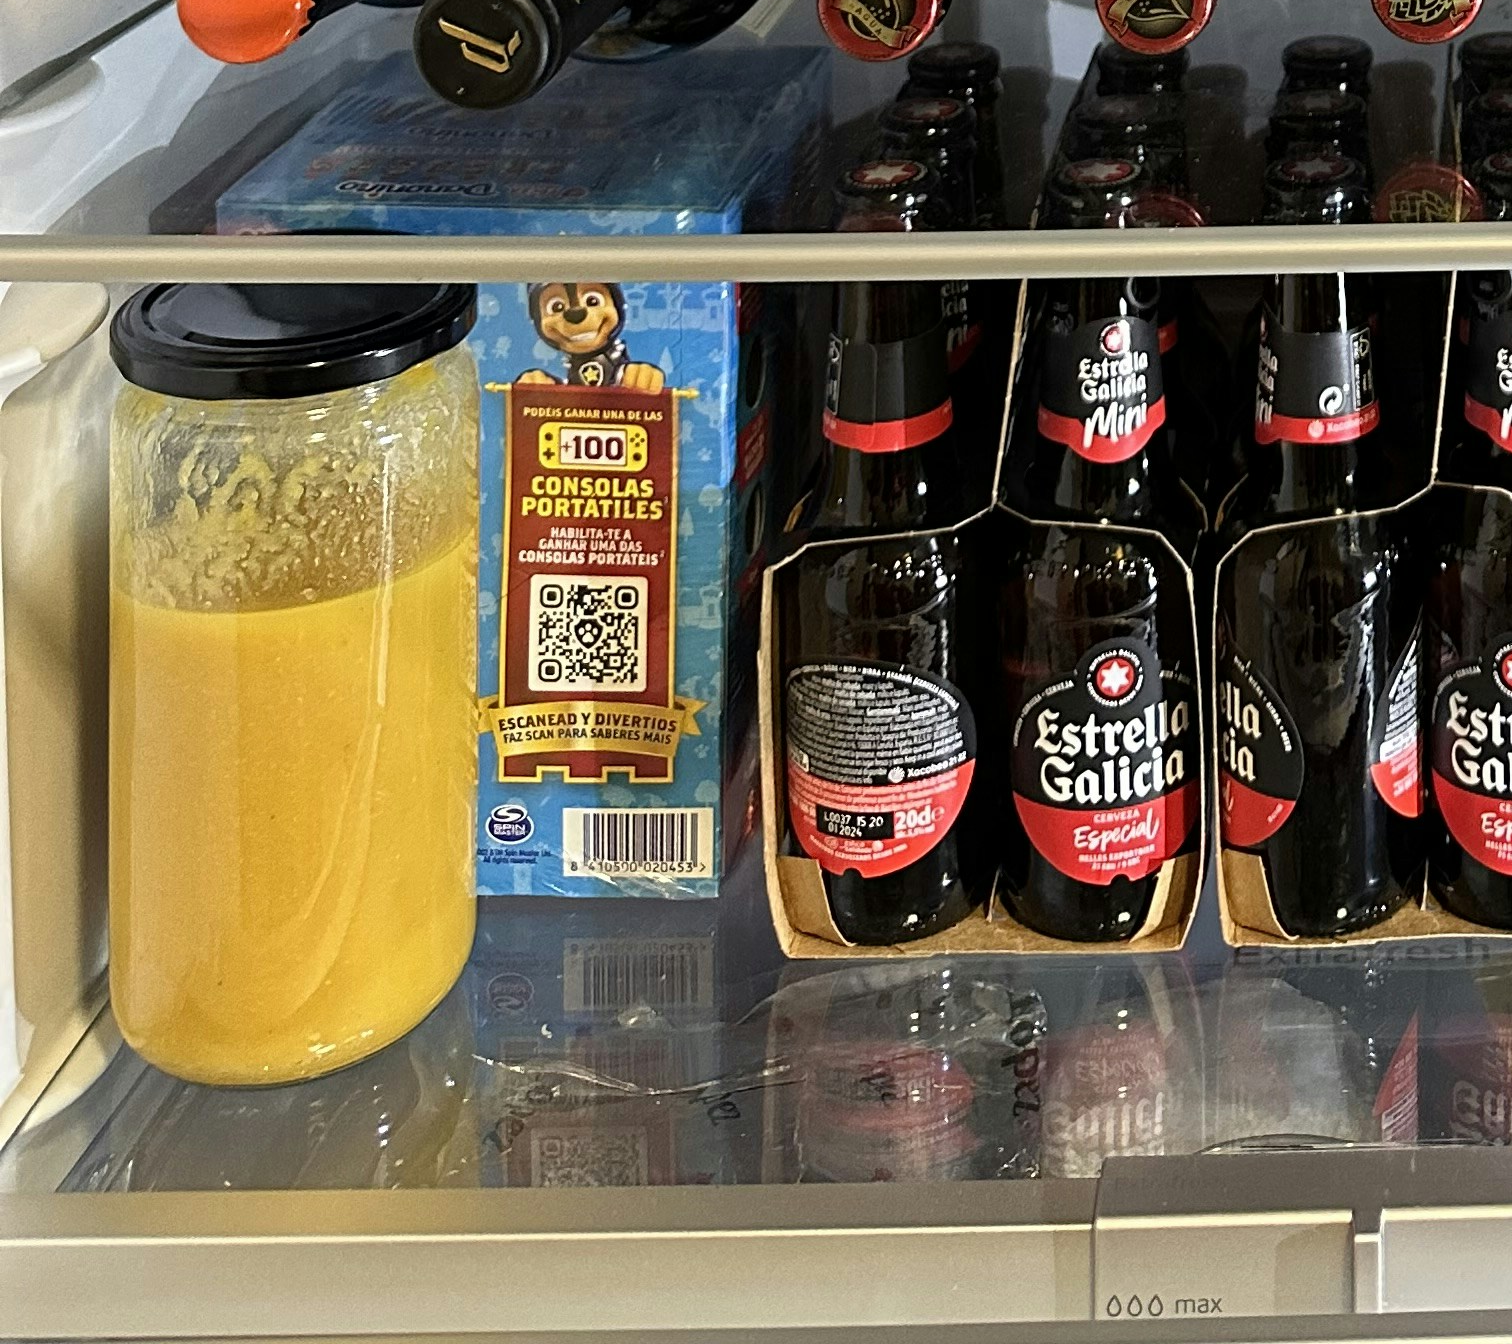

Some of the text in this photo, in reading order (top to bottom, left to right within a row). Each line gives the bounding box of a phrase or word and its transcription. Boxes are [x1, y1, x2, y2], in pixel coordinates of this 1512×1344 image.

[335, 178, 496, 200] Danonino
[1080, 374, 1147, 403] Galicia
[565, 407, 600, 419] GANAR
[603, 409, 625, 420] UNA
[628, 410, 641, 420] DE
[644, 411, 663, 421] LAS
[1083, 393, 1147, 449] Mini
[561, 435, 624, 461] +100
[531, 475, 654, 498] CONSOLAS
[551, 527, 632, 540] HABILITA-TE A
[538, 538, 642, 553] GANHAR UMA DAS
[518, 549, 586, 564] CONSOLAS
[498, 713, 577, 732] ESCANEAD
[580, 712, 591, 725] Y
[1034, 700, 1189, 758] Estrella
[503, 728, 672, 745] FAZ SCAN PARA SABERES MAIS
[907, 760, 949, 778] Xacobeo
[1040, 746, 1185, 804] Galicia
[868, 816, 884, 827] 20
[1093, 809, 1141, 824] CERVEZA
[493, 823, 526, 831] SPIN
[1073, 808, 1160, 851] Especial
[570, 862, 578, 872] 8
[643, 861, 694, 873] 020453
[1174, 1296, 1223, 1315] max
